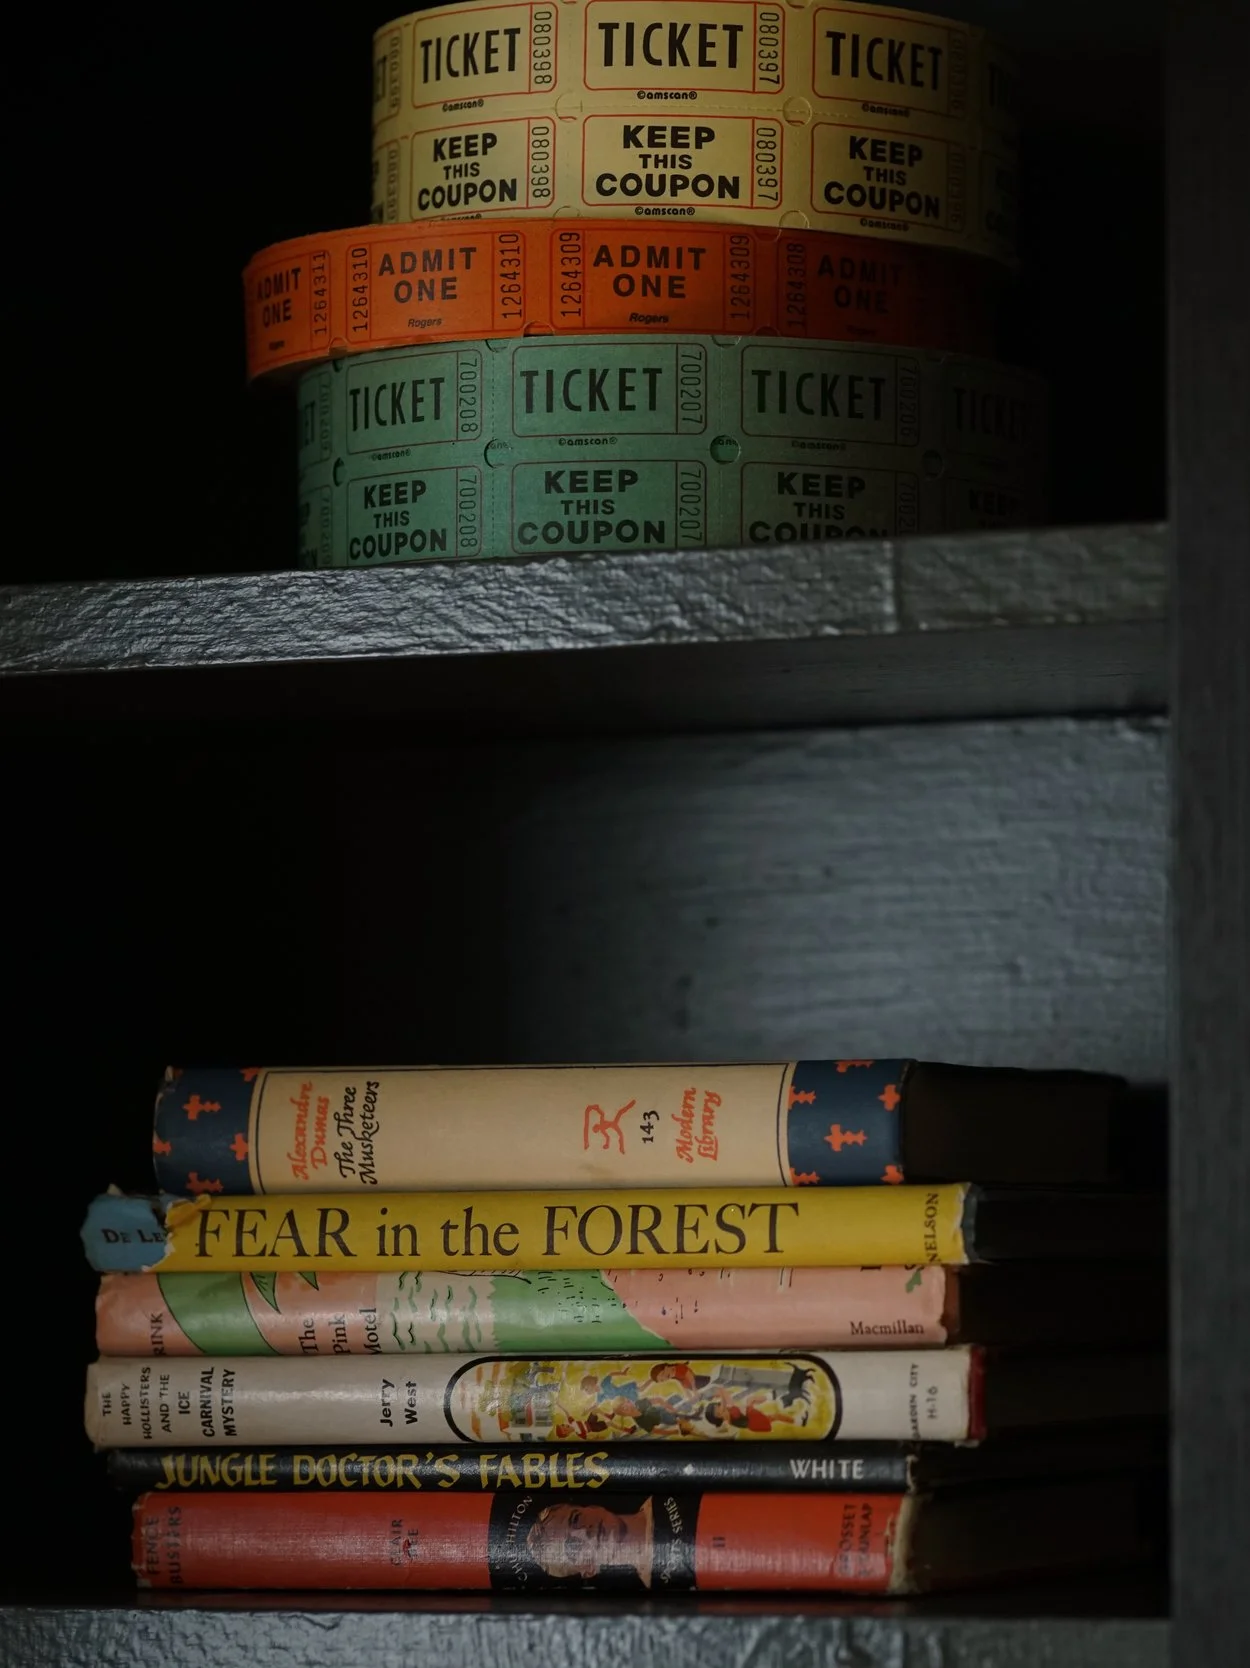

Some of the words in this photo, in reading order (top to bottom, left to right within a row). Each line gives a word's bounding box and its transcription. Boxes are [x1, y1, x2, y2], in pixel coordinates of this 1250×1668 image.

[420, 28, 521, 84] TICKET
[533, 11, 552, 85] 080398
[598, 22, 744, 68] TICKET
[758, 12, 780, 84] 080397
[826, 31, 943, 91] TICKET
[433, 133, 498, 163] KEEP
[623, 125, 715, 150] KEEP
[849, 135, 923, 167] KEEP
[443, 162, 480, 180] THIS
[531, 126, 551, 198] 080398
[638, 154, 693, 169] THIS
[755, 128, 779, 201] 080397
[864, 166, 907, 186] THIS
[418, 178, 517, 211] COUPON
[595, 173, 740, 199] COUPON
[824, 181, 940, 220] COUPON
[378, 246, 477, 277] ADMIT
[499, 232, 522, 319] 1264310
[560, 232, 581, 318] 1264309
[593, 244, 706, 271] ADMIT
[818, 254, 903, 287] ADMIT
[257, 267, 301, 300] ADMIT
[311, 252, 328, 337] 1264311
[352, 247, 369, 333] 1264310
[394, 276, 458, 304] ONE
[613, 273, 686, 298] ONE
[730, 235, 750, 320] 1264309
[786, 242, 806, 328] 1264308
[262, 298, 292, 328] ONE
[628, 312, 669, 324] Rogers
[834, 284, 889, 314] ONE
[407, 316, 443, 329] Rogers
[349, 377, 446, 432] TICKET
[459, 358, 478, 433] 700208
[520, 367, 662, 413] TICKET
[680, 352, 703, 424] 700207
[751, 369, 886, 421] TICKET
[364, 480, 427, 510] KEEP
[544, 469, 639, 494] KEEP
[777, 471, 866, 500] KEEP
[373, 510, 410, 529] THIS
[459, 475, 478, 548] 700208
[560, 499, 615, 516] THIS
[679, 469, 703, 542] 700207
[793, 501, 846, 521] THIS
[350, 528, 447, 560] COUPON
[517, 519, 665, 546] COUPON
[288, 1080, 313, 1180] Alexandre
[333, 1087, 357, 1137] Three
[640, 1110, 660, 1144] 143
[671, 1087, 697, 1164] Modern
[694, 1090, 722, 1161] Library
[311, 1096, 330, 1170] Dumas
[355, 1081, 380, 1185] Musketeers
[333, 1141, 356, 1179] The
[195, 1207, 357, 1258] FEAR
[376, 1207, 421, 1257] in
[440, 1206, 520, 1257] the
[541, 1202, 799, 1257] FOREST
[924, 1193, 941, 1263] NELSON
[298, 1317, 318, 1354] The
[329, 1314, 350, 1354] Pink
[850, 1319, 924, 1336] Macmillan
[159, 1373, 171, 1400] THE
[909, 1362, 920, 1389] CITY
[102, 1392, 111, 1417] THE
[122, 1383, 131, 1426] HAPPY
[143, 1366, 152, 1440] HOLLISTERS
[160, 1405, 173, 1433] AND
[178, 1391, 191, 1415] ICE
[202, 1366, 216, 1438] CARNIVAL
[222, 1368, 238, 1437] MYSTERY
[379, 1377, 396, 1428] Jerry
[404, 1380, 418, 1425] West
[154, 1452, 277, 1490] JUNGLE
[292, 1451, 461, 1490] DOCTOR'S
[478, 1451, 611, 1489] FABLES
[789, 1459, 865, 1481] WHITE
[506, 1495, 534, 1543] HILTON
[663, 1496, 683, 1534] SERIES
